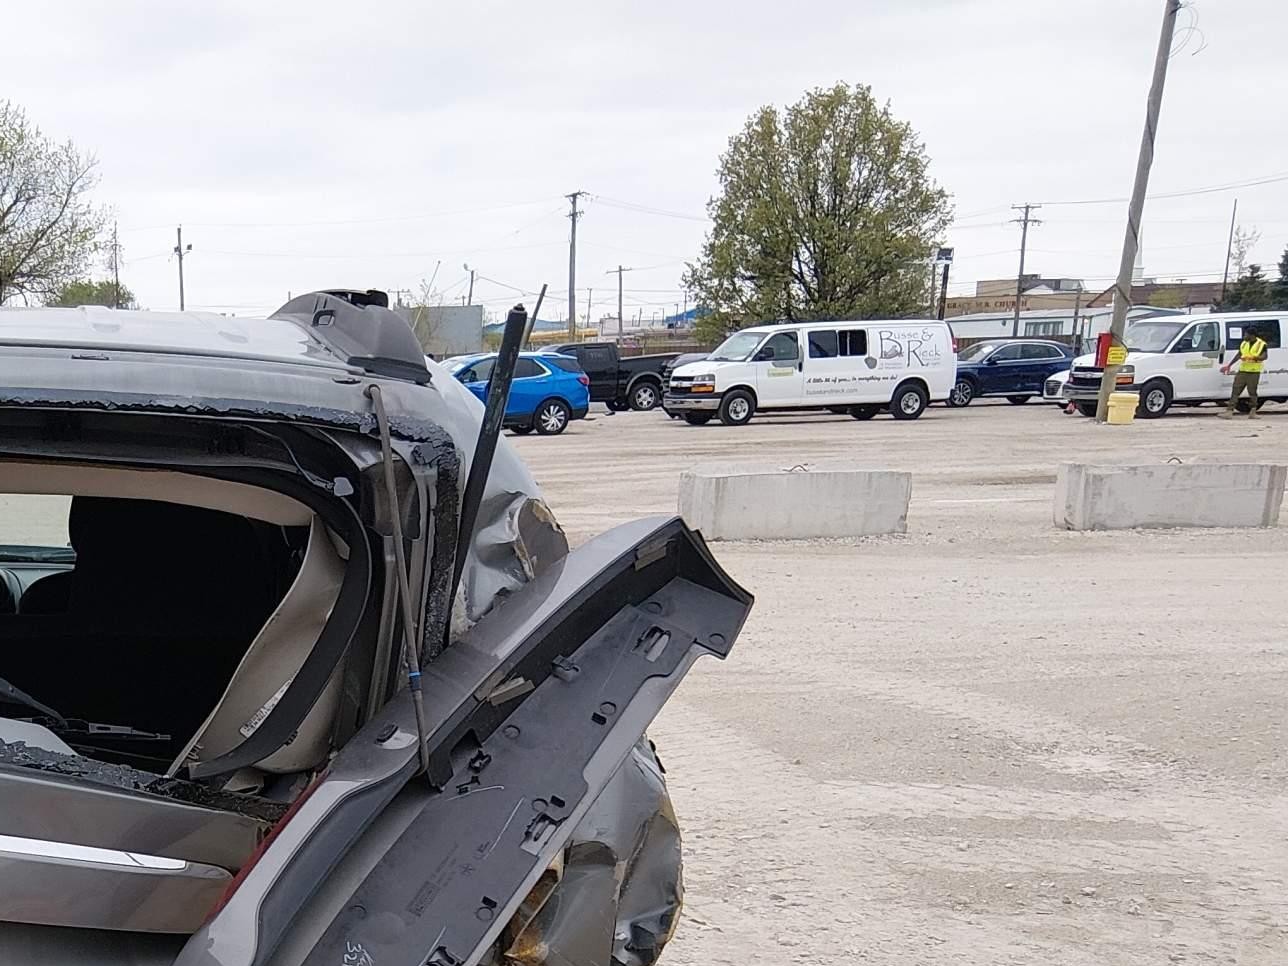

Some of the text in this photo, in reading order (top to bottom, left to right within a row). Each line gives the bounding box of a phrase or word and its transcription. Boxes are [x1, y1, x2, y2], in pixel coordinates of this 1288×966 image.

[994, 300, 1027, 308] CHURH
[879, 328, 934, 359] Busse &
